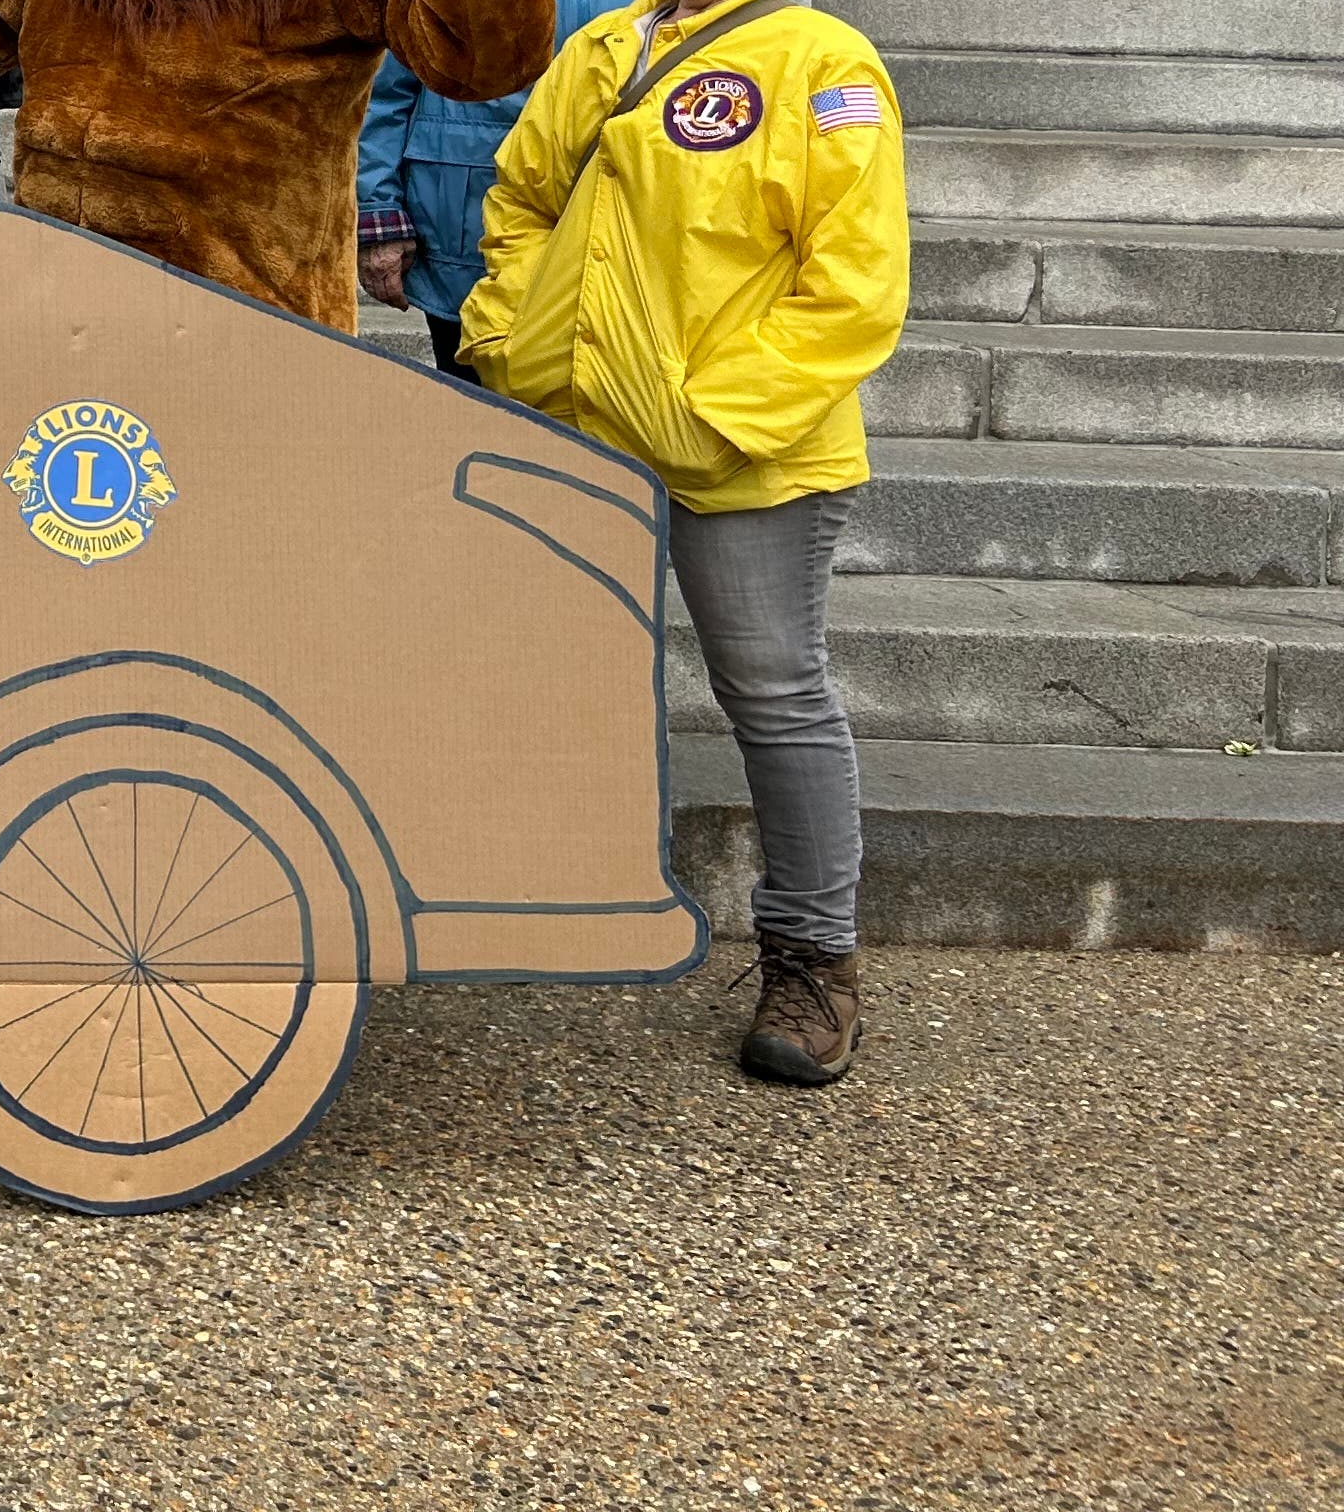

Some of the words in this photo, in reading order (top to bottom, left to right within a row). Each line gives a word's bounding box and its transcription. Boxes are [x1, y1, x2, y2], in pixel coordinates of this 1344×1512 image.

[704, 80, 744, 97] LIONS
[695, 96, 721, 123] L
[43, 405, 143, 444] LIONS
[71, 450, 114, 508] L
[38, 518, 137, 553] INTERNATIONAL
